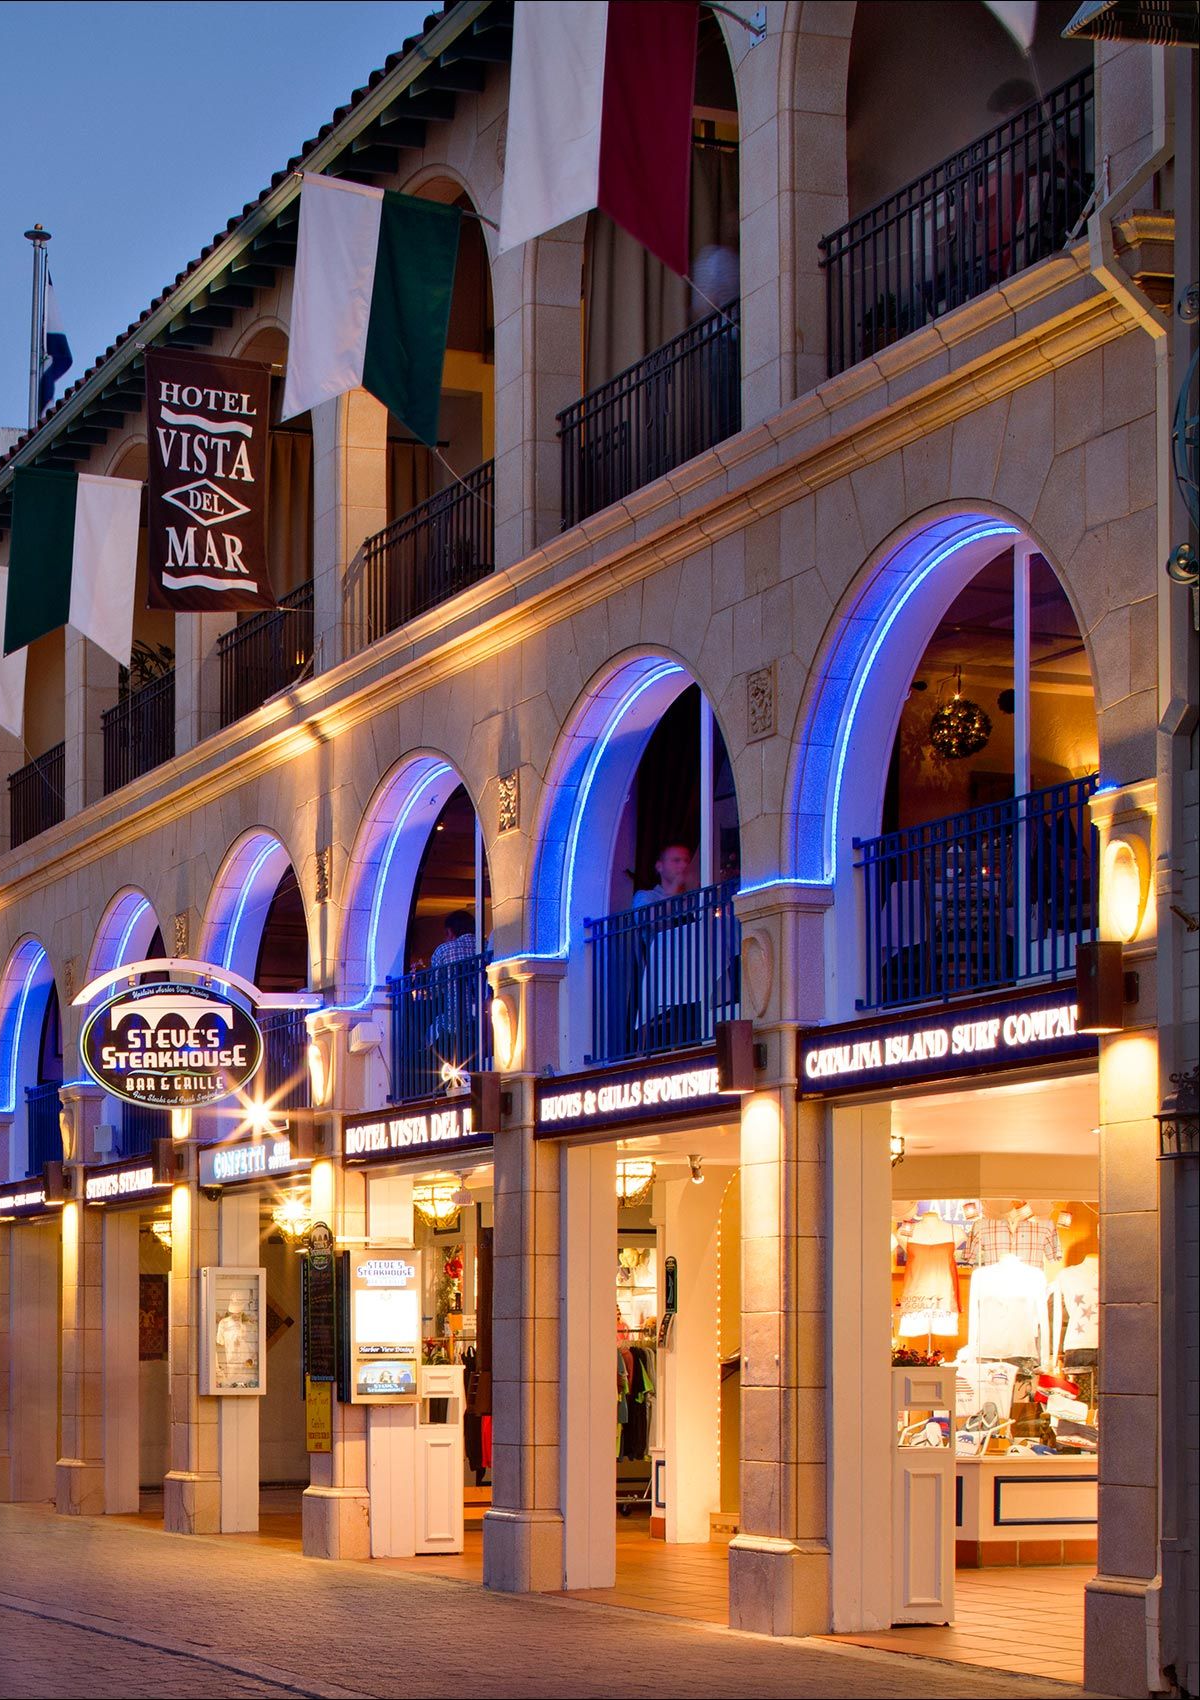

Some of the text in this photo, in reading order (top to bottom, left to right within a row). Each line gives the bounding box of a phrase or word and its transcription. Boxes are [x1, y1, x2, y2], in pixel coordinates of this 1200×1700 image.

[158, 380, 257, 416] HOTEL
[156, 426, 256, 483] VISTA
[188, 489, 225, 516] DEL
[165, 526, 250, 574] MAR
[127, 1028, 220, 1049] STEVE'S
[805, 1039, 883, 1078] CATALINA
[884, 1030, 949, 1066] ISLAND
[950, 1019, 1000, 1055] SURF
[101, 1044, 247, 1070] STEAKHOUSE
[126, 1076, 224, 1091] BAR & GRILLE
[147, 1093, 166, 1104] Steaks
[167, 1096, 179, 1104] and
[540, 1093, 582, 1122] BUOYS
[582, 1090, 597, 1114] &
[597, 1081, 642, 1112] GULLS
[345, 1123, 388, 1155] HOTEL
[389, 1115, 428, 1148] VISTA
[430, 1110, 460, 1140] DEL
[357, 1267, 412, 1276] STEAKHOUSE
